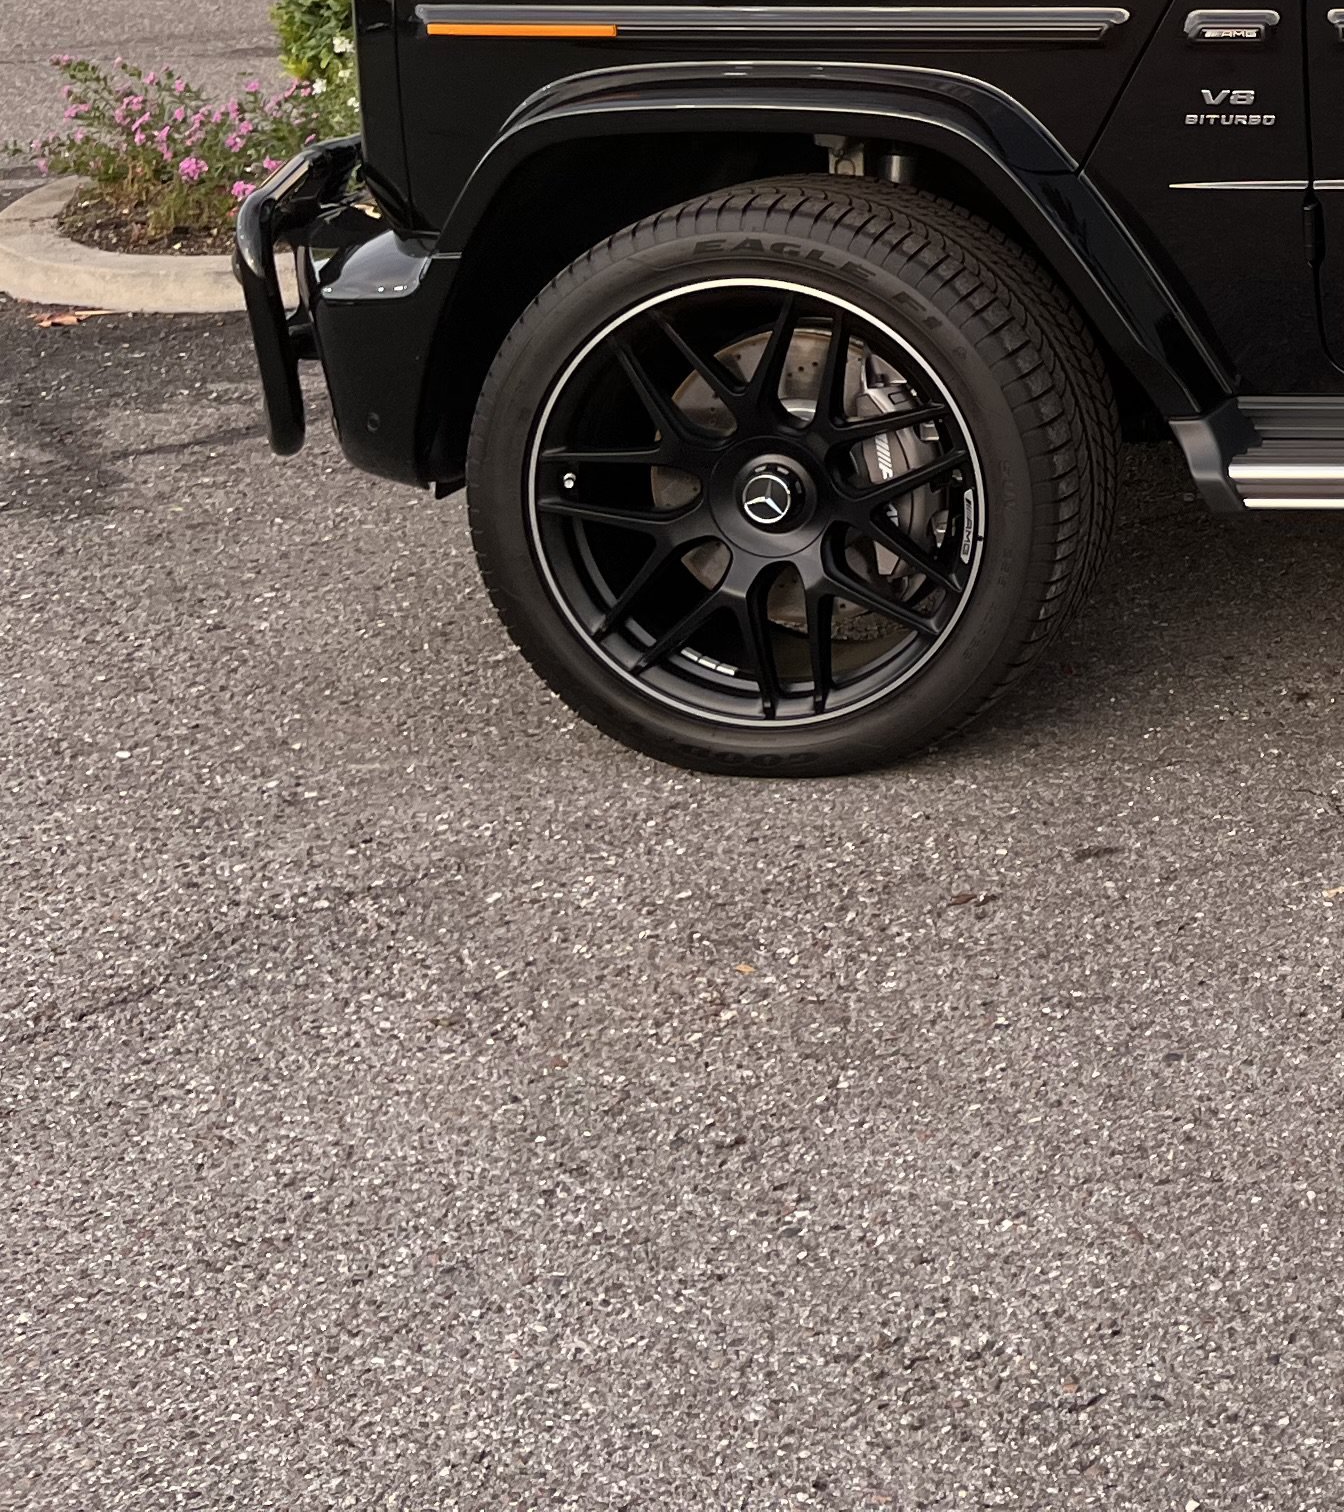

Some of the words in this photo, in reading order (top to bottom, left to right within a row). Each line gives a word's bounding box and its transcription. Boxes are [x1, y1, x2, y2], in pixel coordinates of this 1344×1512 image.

[1201, 90, 1255, 105] V8
[1184, 114, 1276, 126] BITURBO
[693, 238, 877, 284] EAGLE
[890, 291, 943, 331] F1
[962, 518, 974, 556] AMG
